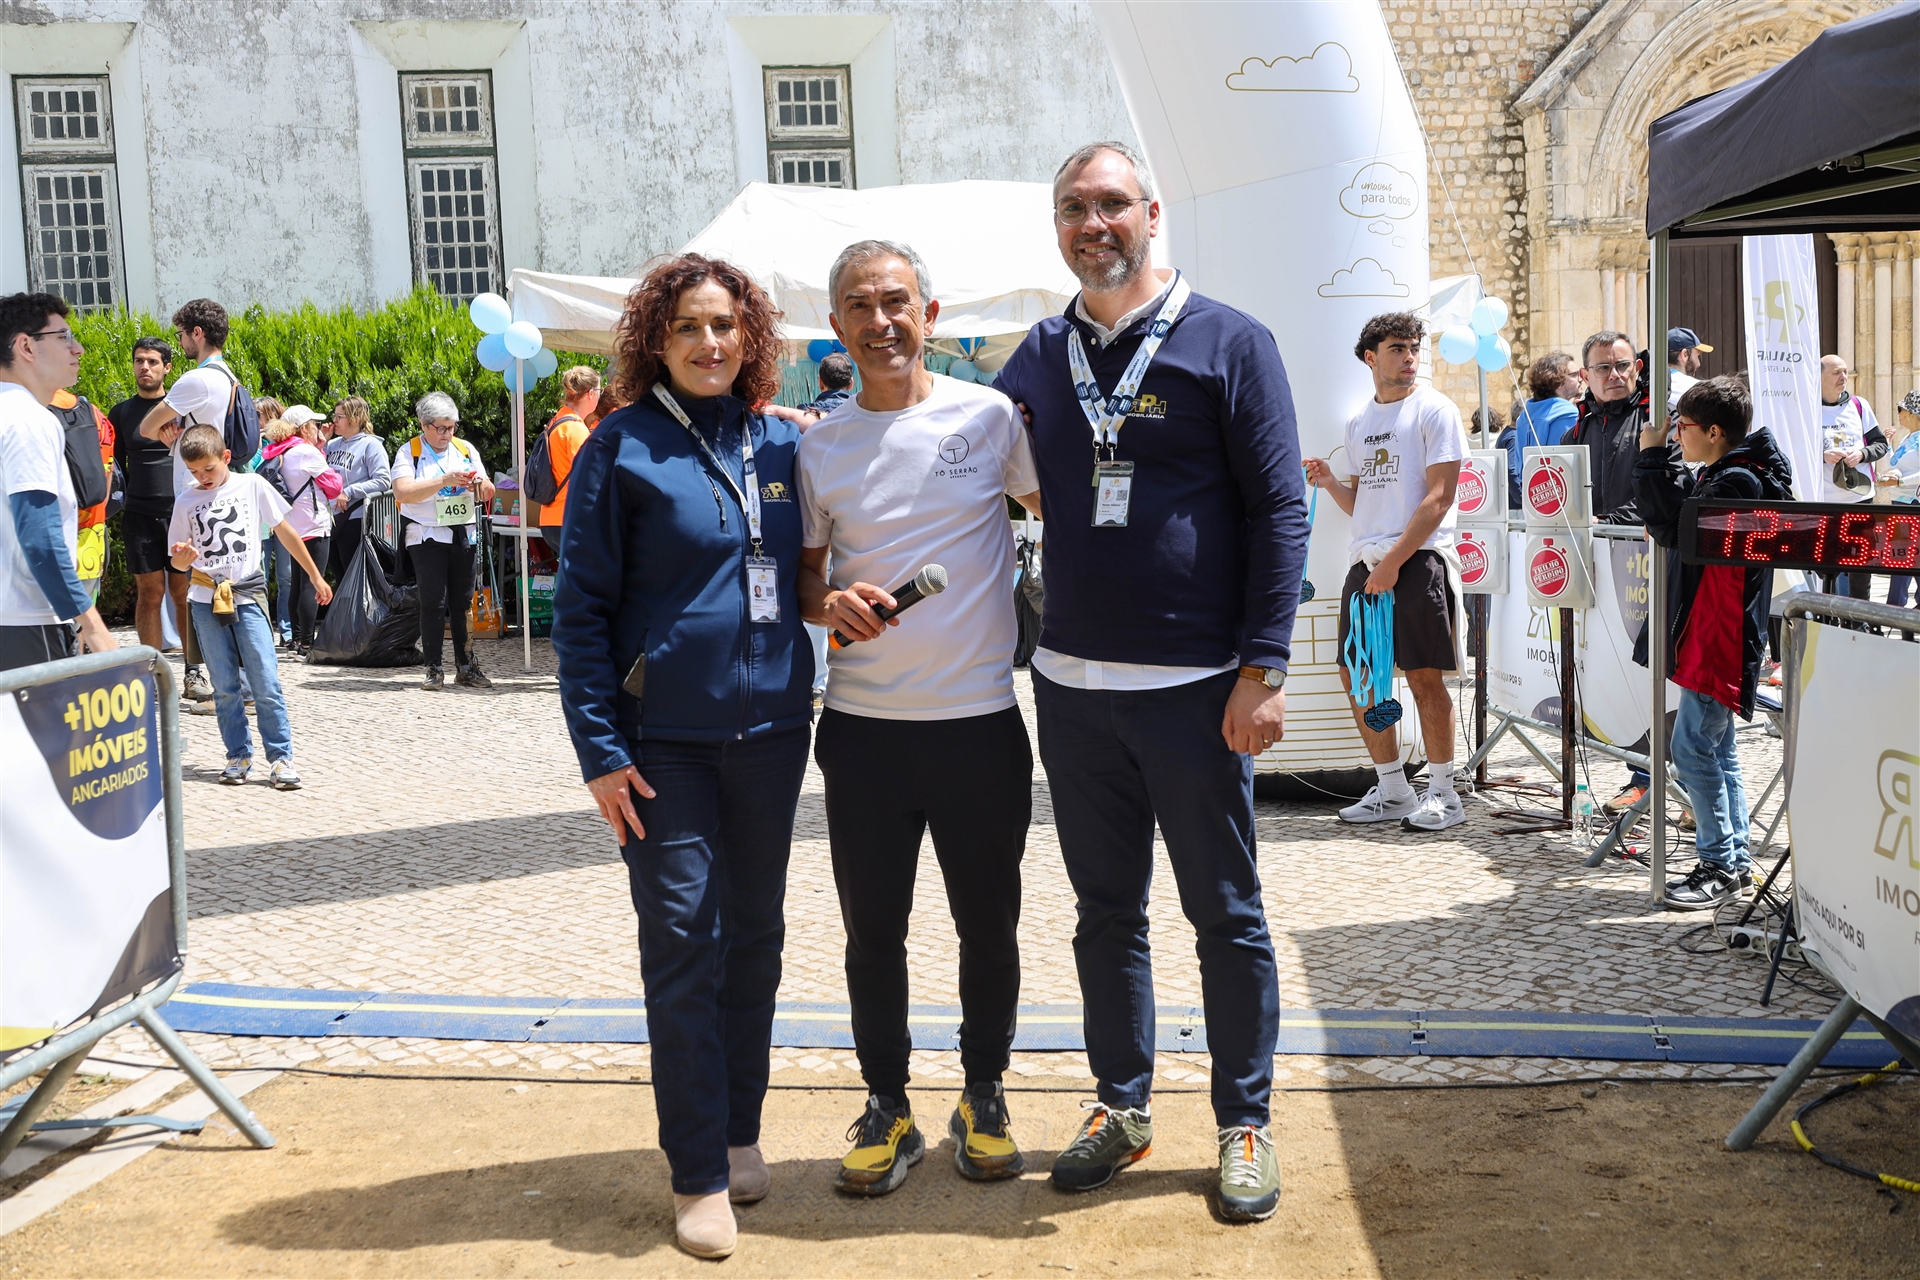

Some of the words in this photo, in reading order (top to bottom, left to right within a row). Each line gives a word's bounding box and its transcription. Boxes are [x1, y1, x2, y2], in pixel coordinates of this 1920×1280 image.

[1361, 180, 1392, 191] imóveis
[1361, 193, 1385, 205] para
[1388, 194, 1411, 206] todos
[326, 450, 355, 470] OOKLYN
[195, 498, 239, 512] CARIOCA
[445, 504, 467, 515] 463
[63, 678, 146, 732] +1000
[69, 727, 148, 778] IMÓVEIS
[71, 761, 148, 806] ANGARIADOS
[1821, 904, 1838, 931] AQUI
[1838, 917, 1855, 944] POR
[1856, 930, 1866, 951] SI
